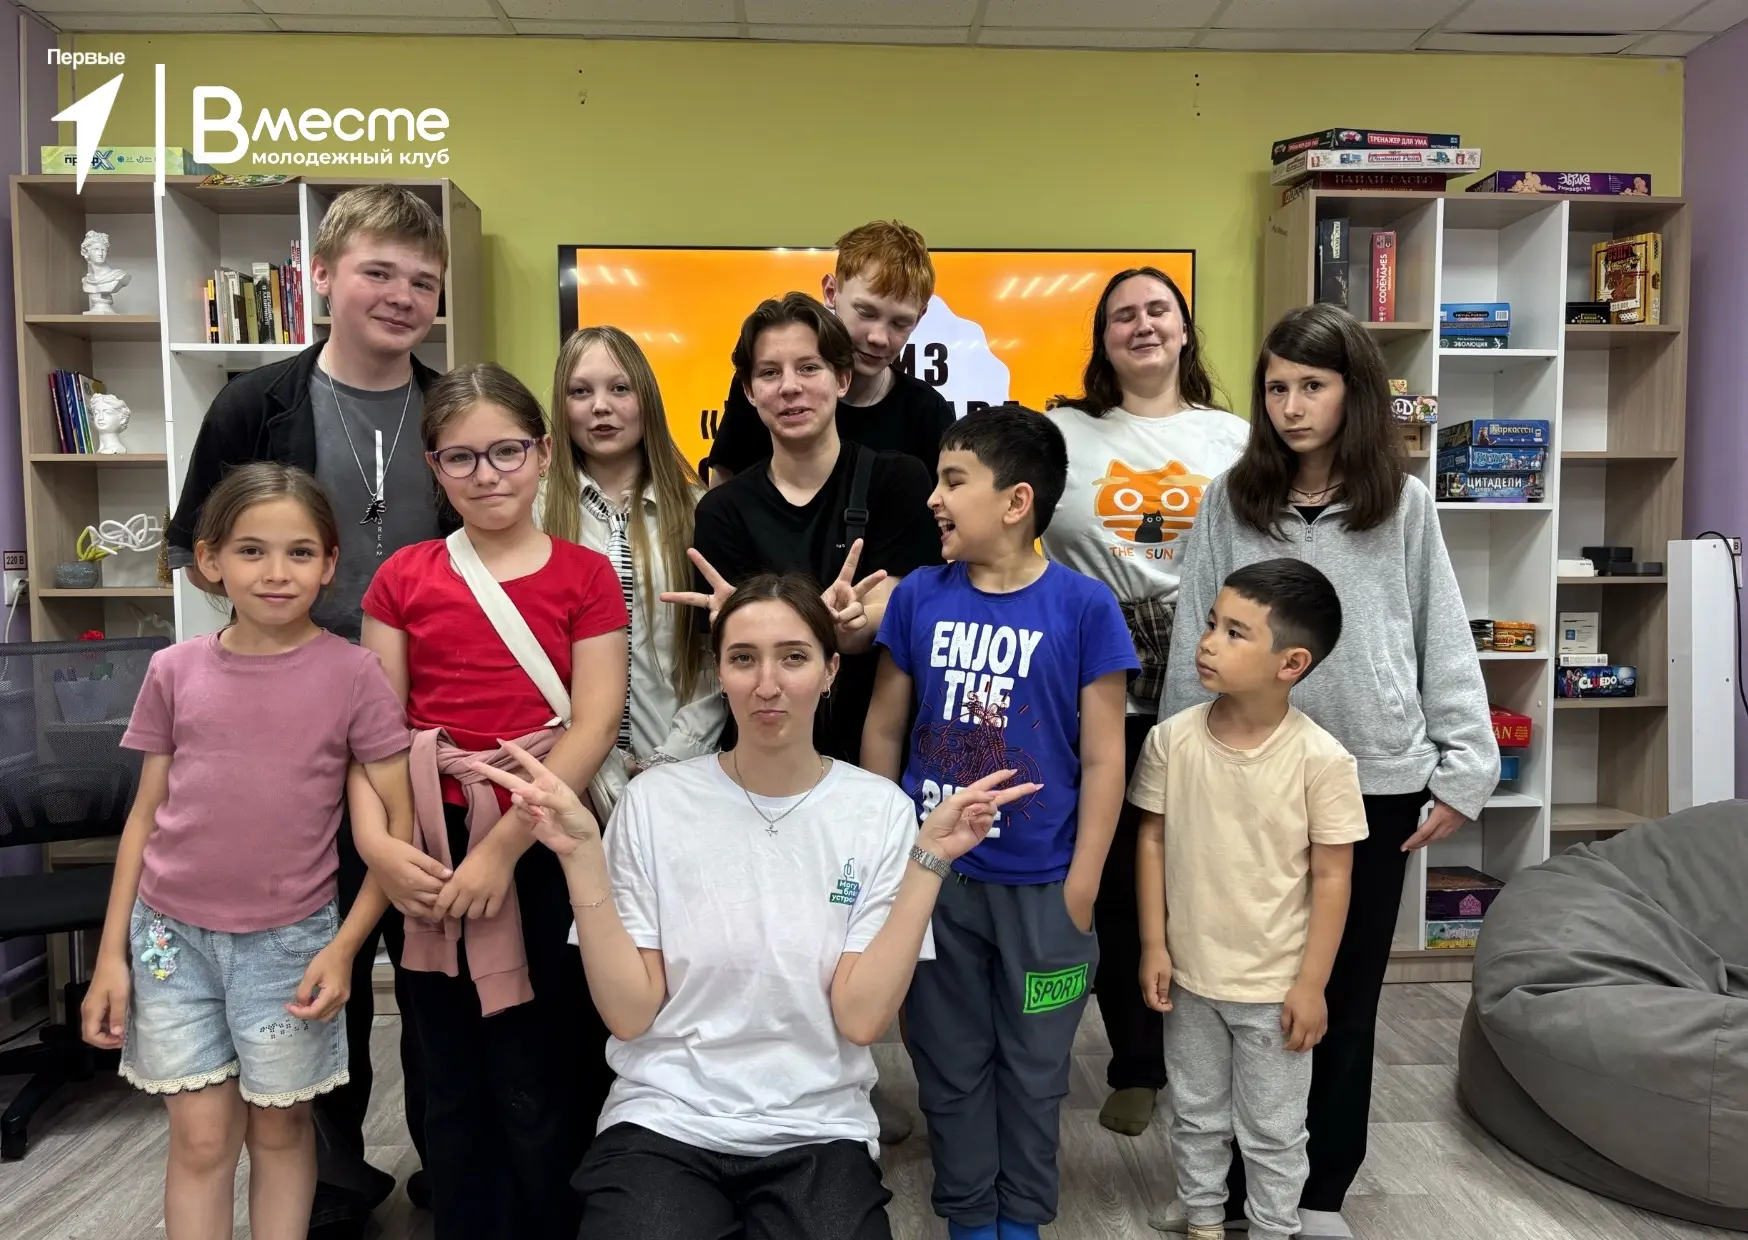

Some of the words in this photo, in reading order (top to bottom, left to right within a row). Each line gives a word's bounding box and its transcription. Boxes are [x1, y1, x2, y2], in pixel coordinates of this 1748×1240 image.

[1370, 135, 1401, 144] ТРЕНАЖЕР
[1401, 137, 1414, 146] ДЛЯ
[1414, 138, 1428, 146] УМА
[1379, 253, 1388, 304] CODENAMES
[1467, 477, 1522, 489] ЦИТАДЕЛИ
[1109, 547, 1134, 558] THE
[1145, 548, 1174, 559] SUN
[7, 556, 17, 565] 220
[930, 620, 1043, 678] ENJOY
[1578, 675, 1618, 690] CLUEDO
[942, 669, 1015, 728] THE
[840, 880, 857, 890] Могу
[1032, 975, 1080, 1004] SPORT
